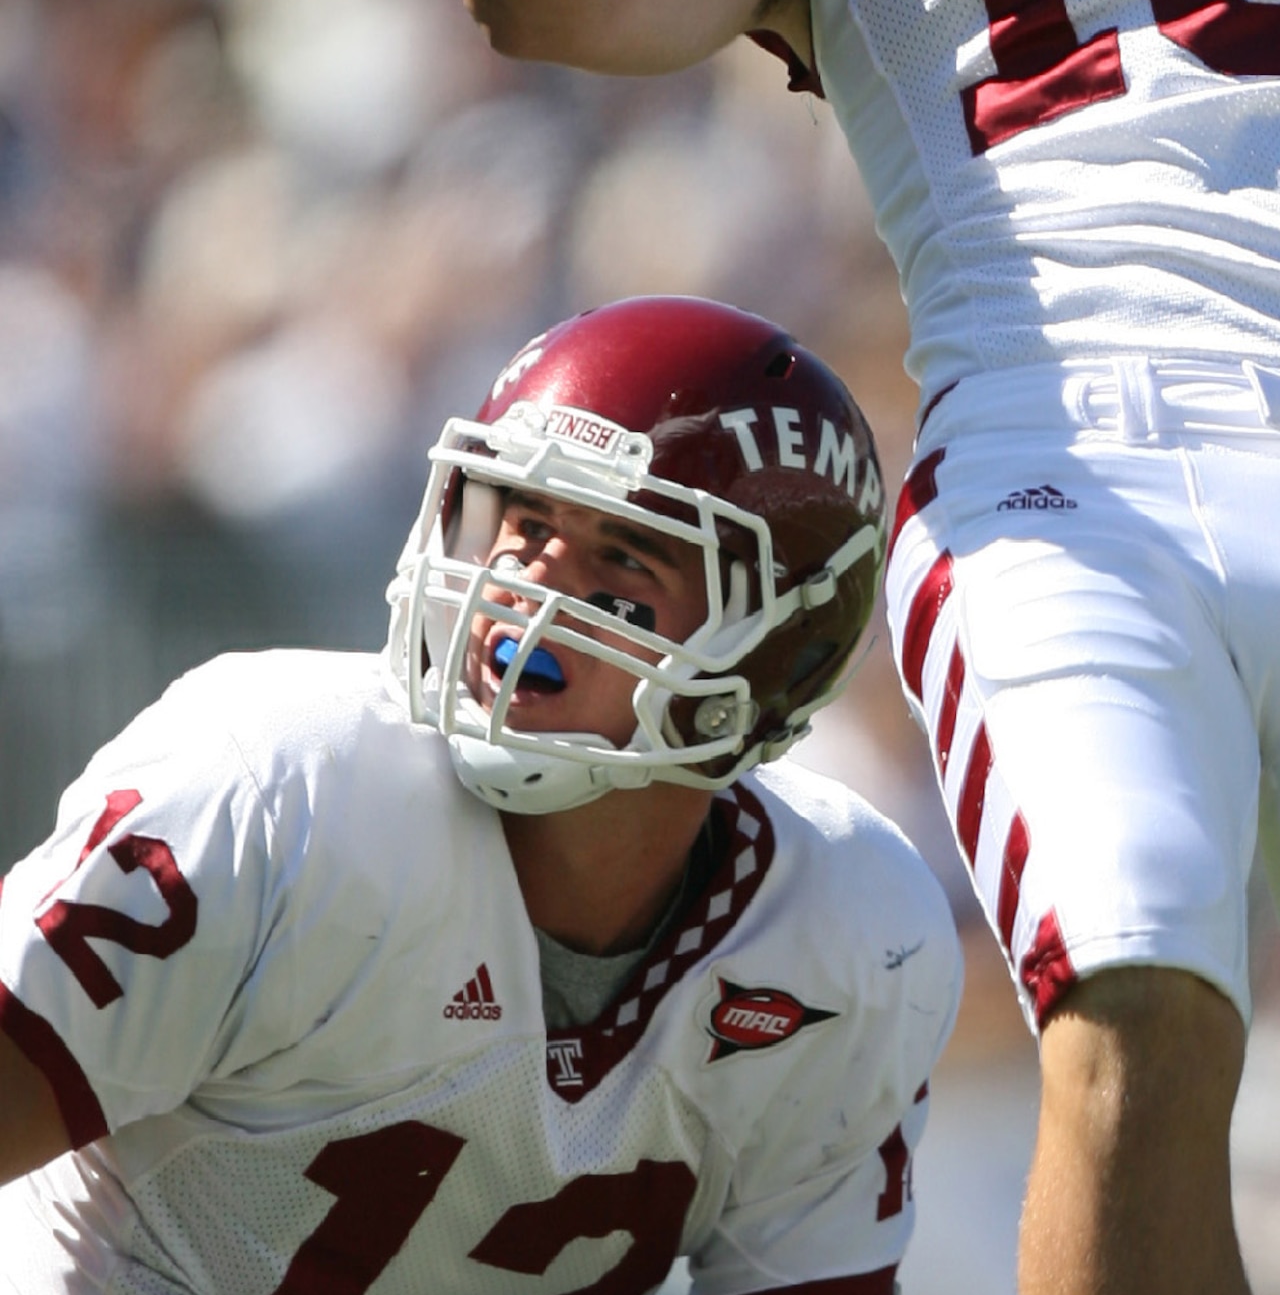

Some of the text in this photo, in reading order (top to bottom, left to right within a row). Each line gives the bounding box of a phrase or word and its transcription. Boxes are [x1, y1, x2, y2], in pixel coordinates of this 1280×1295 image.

[548, 410, 616, 450] FINISH
[443, 1002, 502, 1020] adidas
[722, 1007, 791, 1036] MAC
[547, 1039, 583, 1087] T
